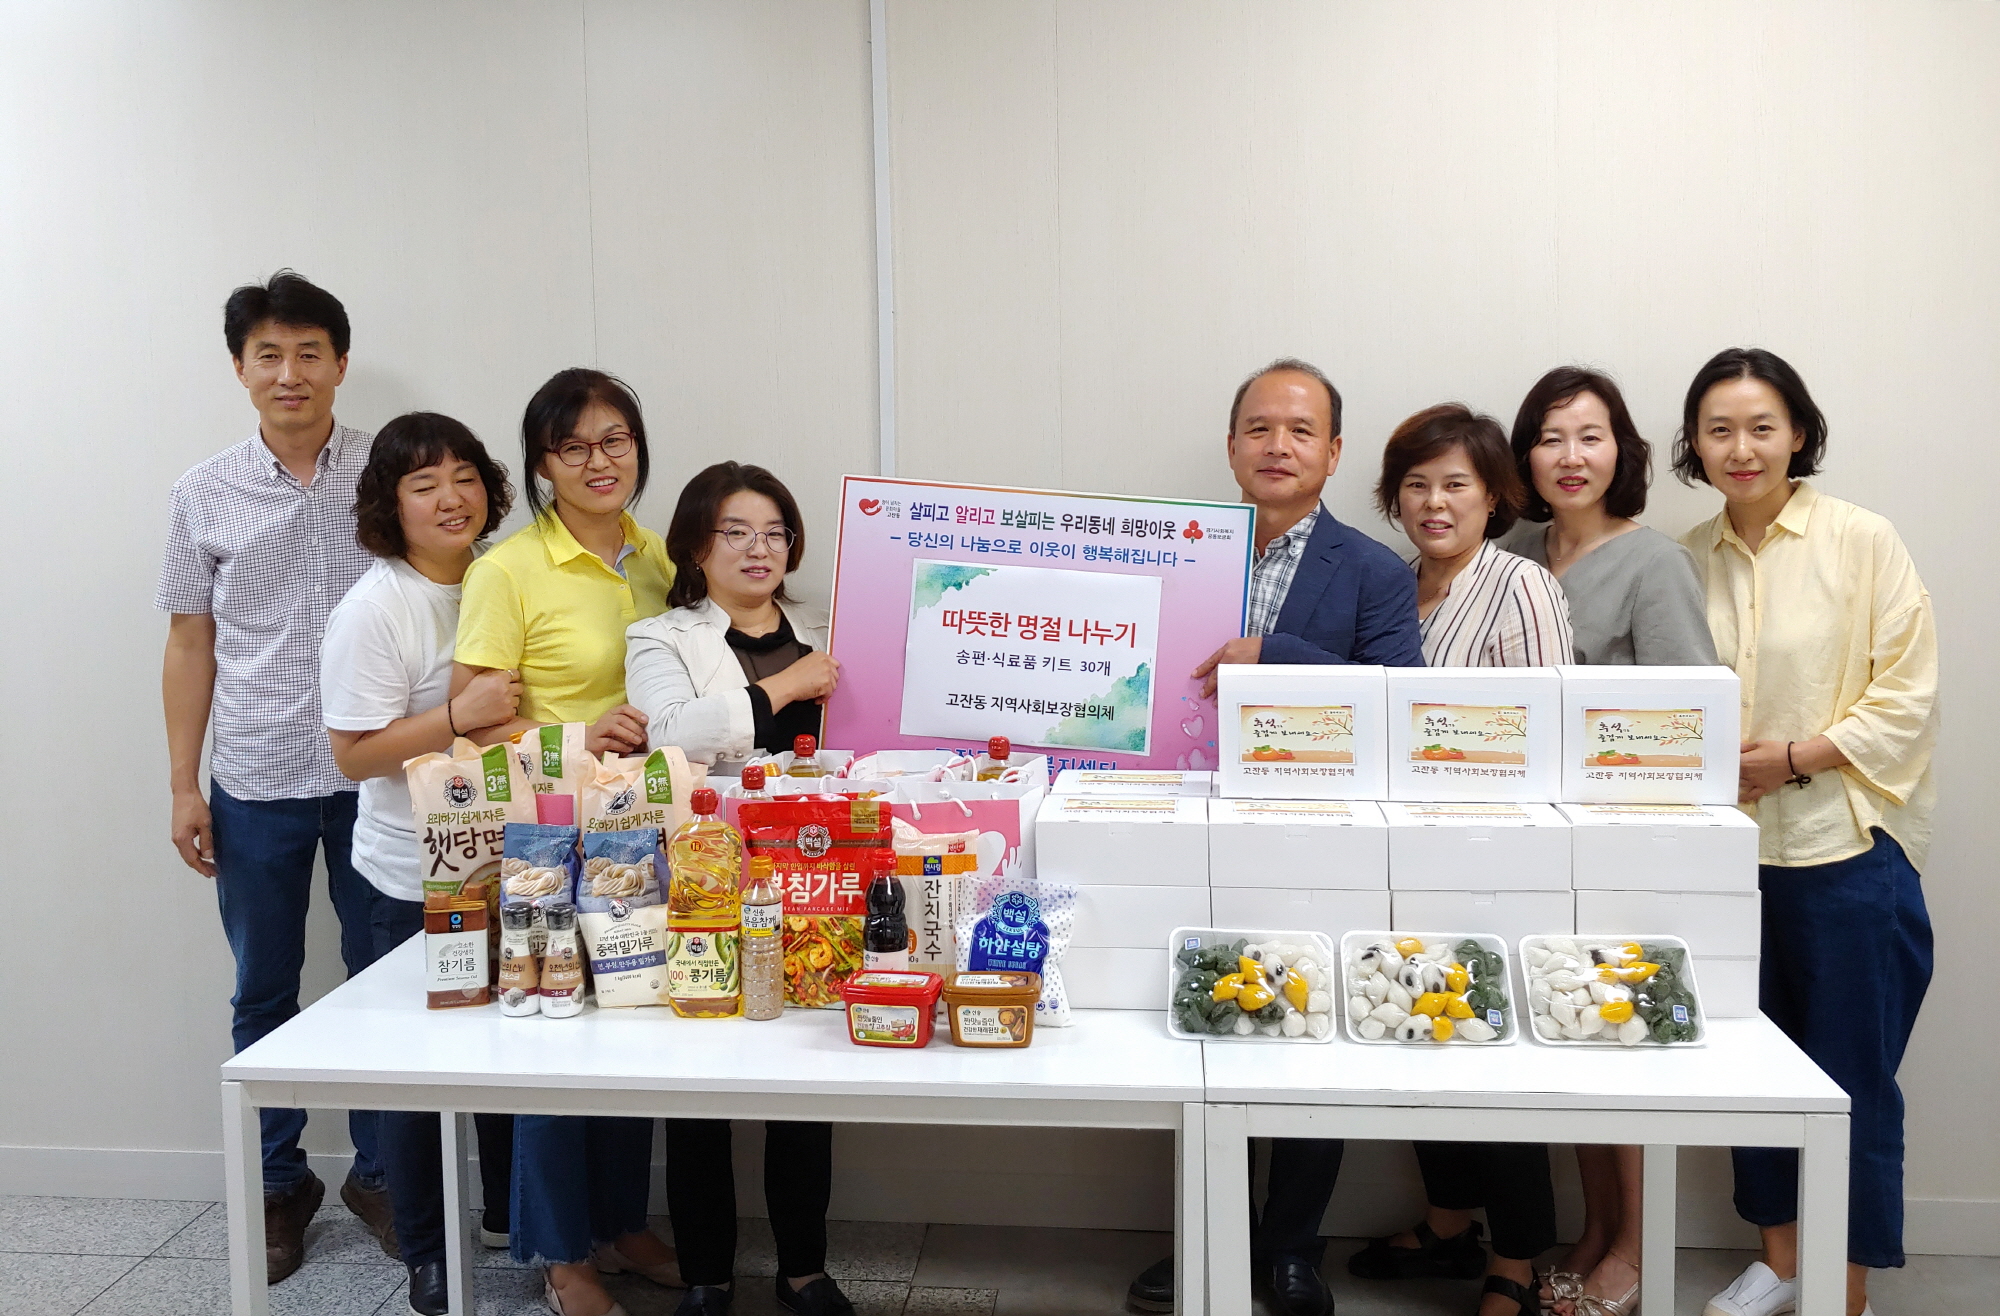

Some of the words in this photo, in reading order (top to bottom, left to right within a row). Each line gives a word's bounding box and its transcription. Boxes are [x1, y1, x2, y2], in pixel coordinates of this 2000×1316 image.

[910, 501, 949, 522] 살피고
[955, 505, 995, 525] 알리고
[1000, 509, 1055, 531] 보살피는
[1060, 513, 1115, 535] 우리동네
[1121, 518, 1176, 540] 희망이웃
[907, 532, 954, 550] 당신의
[960, 536, 1022, 554] 나눔으로
[1029, 540, 1076, 559] 이웃이
[1082, 544, 1178, 567] 행복해집니다
[942, 609, 1012, 638] 따뜻한
[1017, 614, 1061, 642] 명절
[1068, 619, 1136, 648] 나누기
[956, 649, 1037, 670] 송편·식료품
[1042, 657, 1072, 672] 키트
[1080, 661, 1111, 676] 30개
[946, 693, 987, 710] 고잔동
[991, 696, 1114, 720] 지역사회보장협의체
[1254, 717, 1276, 728] 추석
[1424, 715, 1447, 727] 추석
[1599, 722, 1622, 733] 추석
[1423, 728, 1449, 736] 즐겁게
[1598, 734, 1623, 742] 즐겁게
[1243, 767, 1269, 775] 고잔동
[1274, 767, 1354, 776] 지역사회보장협의체
[1411, 765, 1439, 774] 고잔동
[1443, 766, 1526, 778] 지역사회보장협의체
[1586, 772, 1614, 780] 고잔동
[1618, 772, 1703, 781] 지역사회보장협의체
[452, 788, 469, 799] 백설
[426, 811, 460, 826] 요리하기
[460, 811, 482, 825] 쉽게
[483, 808, 506, 822] 자른
[619, 814, 641, 830] 쉽게
[642, 809, 665, 824] 자른
[805, 836, 821, 848] 백설
[773, 862, 789, 871] 지막
[924, 863, 941, 872] 면사랑
[752, 909, 765, 917] 신송
[1003, 908, 1027, 923] 백설
[744, 915, 777, 928] 볶음참깨
[924, 879, 942, 961] 잔치국수
[978, 936, 1042, 959] 하얀설탕
[438, 957, 477, 973] 참기름
[689, 968, 726, 983] 콩기름
